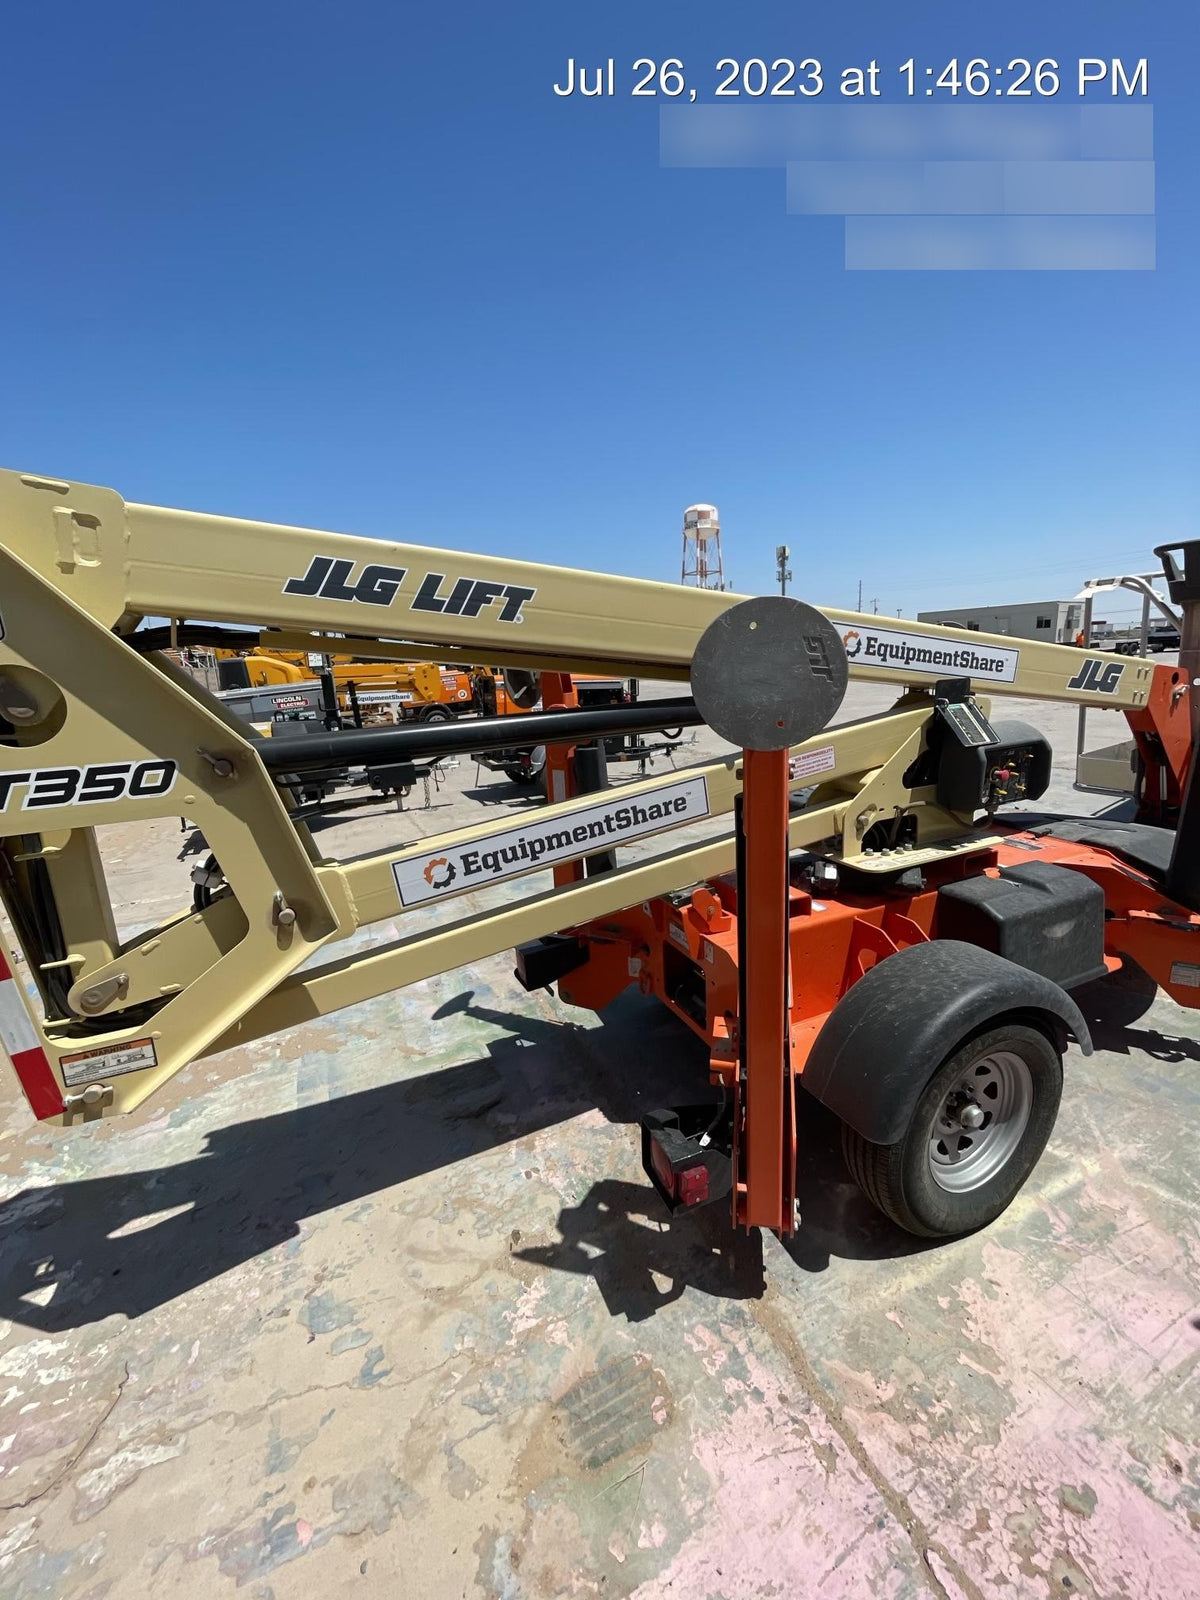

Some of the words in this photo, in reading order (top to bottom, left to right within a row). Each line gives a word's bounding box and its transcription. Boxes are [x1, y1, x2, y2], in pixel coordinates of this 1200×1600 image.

[282, 556, 408, 606] JLG
[410, 573, 536, 623] LIFT
[864, 636, 1005, 673] EquipmentShare
[1068, 658, 1124, 692] JLG
[272, 696, 302, 704] LINCOLN
[460, 795, 687, 876] EquipmentShare
[92, 1043, 131, 1058] WARNING
